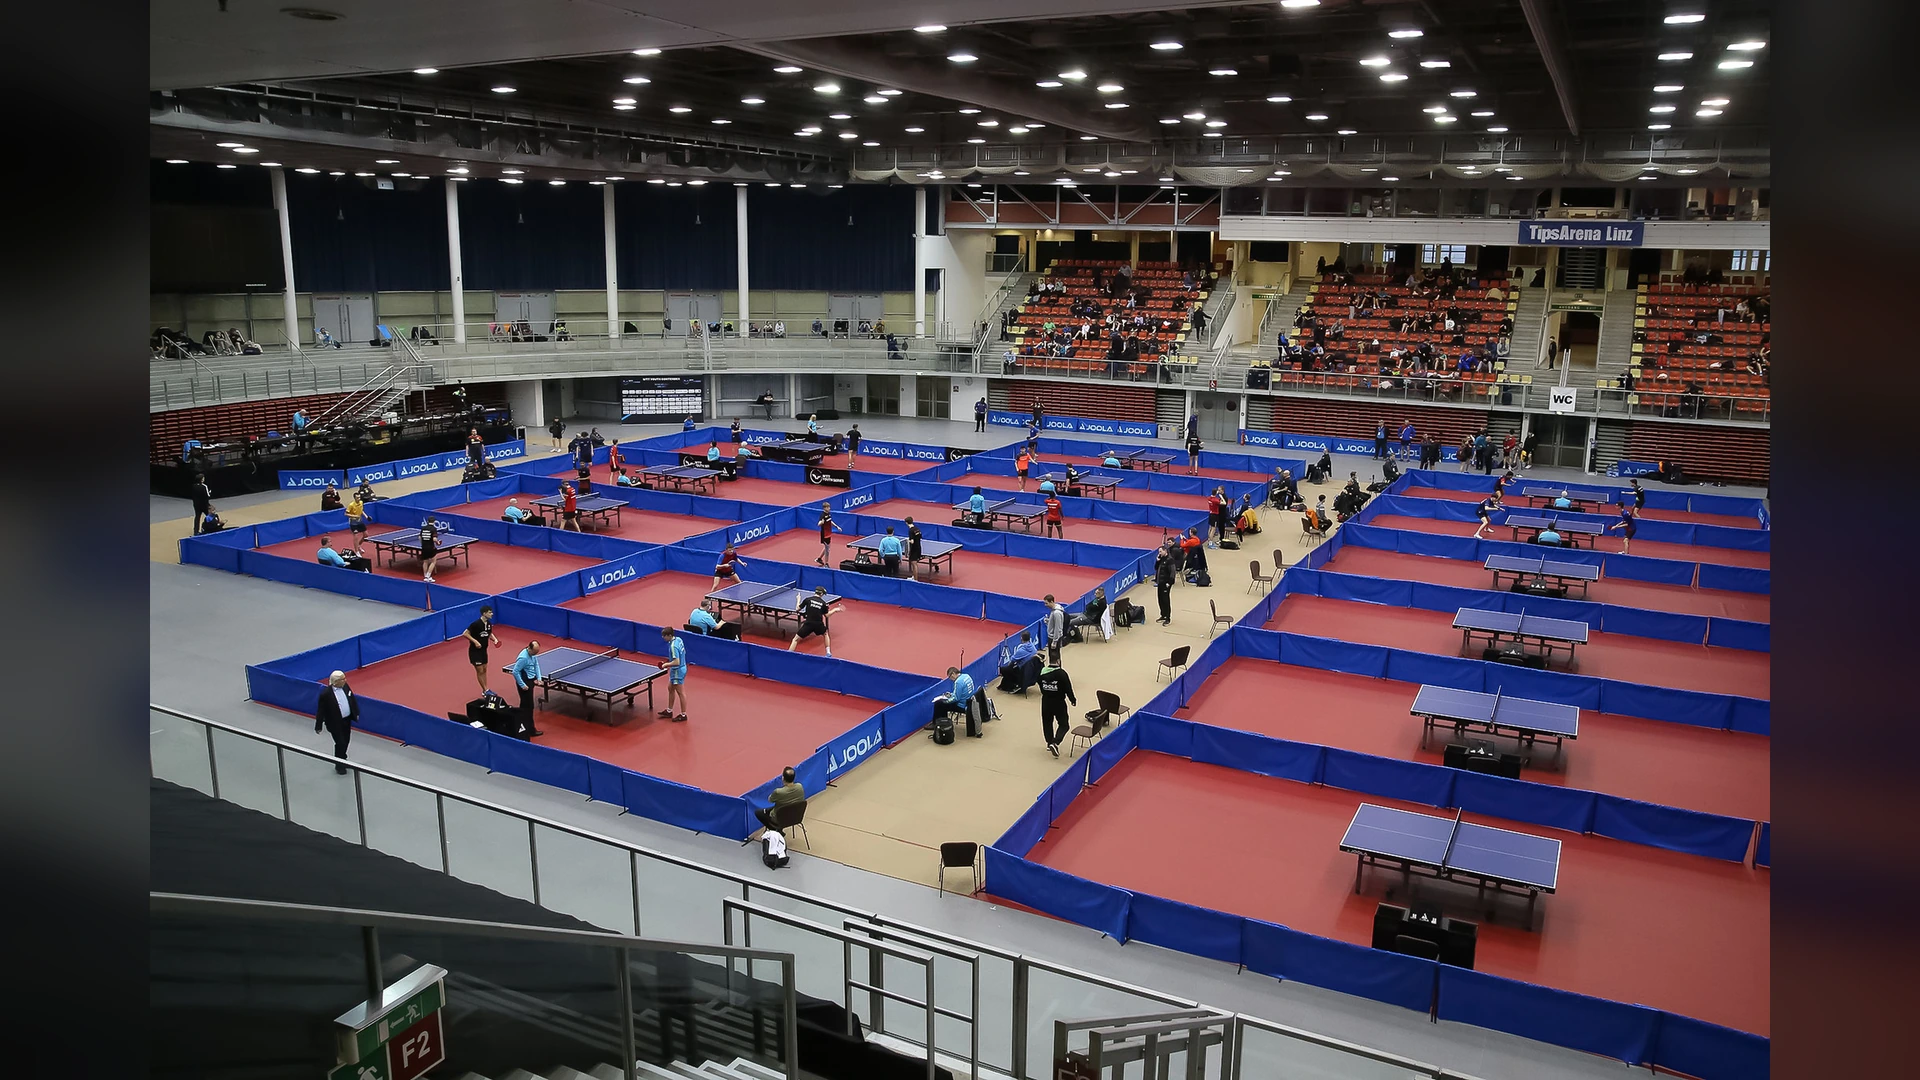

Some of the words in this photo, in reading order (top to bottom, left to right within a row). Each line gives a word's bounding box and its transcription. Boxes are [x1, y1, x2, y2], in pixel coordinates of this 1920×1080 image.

[1529, 225, 1601, 243] TipsArena
[1606, 225, 1633, 241] Linz
[1553, 394, 1573, 404] WC
[1046, 420, 1074, 429] JOOLA
[1086, 423, 1114, 433] JOOLA
[1123, 427, 1152, 436] JOOLA
[1249, 436, 1279, 446] JOOLA
[1295, 440, 1327, 450] JOOLA
[495, 447, 522, 459] JOOLA
[869, 446, 899, 456] JOOLA
[1344, 443, 1376, 454] JOOLA
[914, 449, 945, 460] JOOLA
[408, 461, 439, 474] JOOLA
[297, 477, 339, 487] JOOLA
[850, 493, 873, 508] JOOLA
[741, 524, 770, 543] JOOLA
[598, 565, 636, 586] JOOLA
[1119, 570, 1138, 591] JOOLA
[839, 728, 883, 768] JOOLA
[402, 1030, 431, 1069] F2
